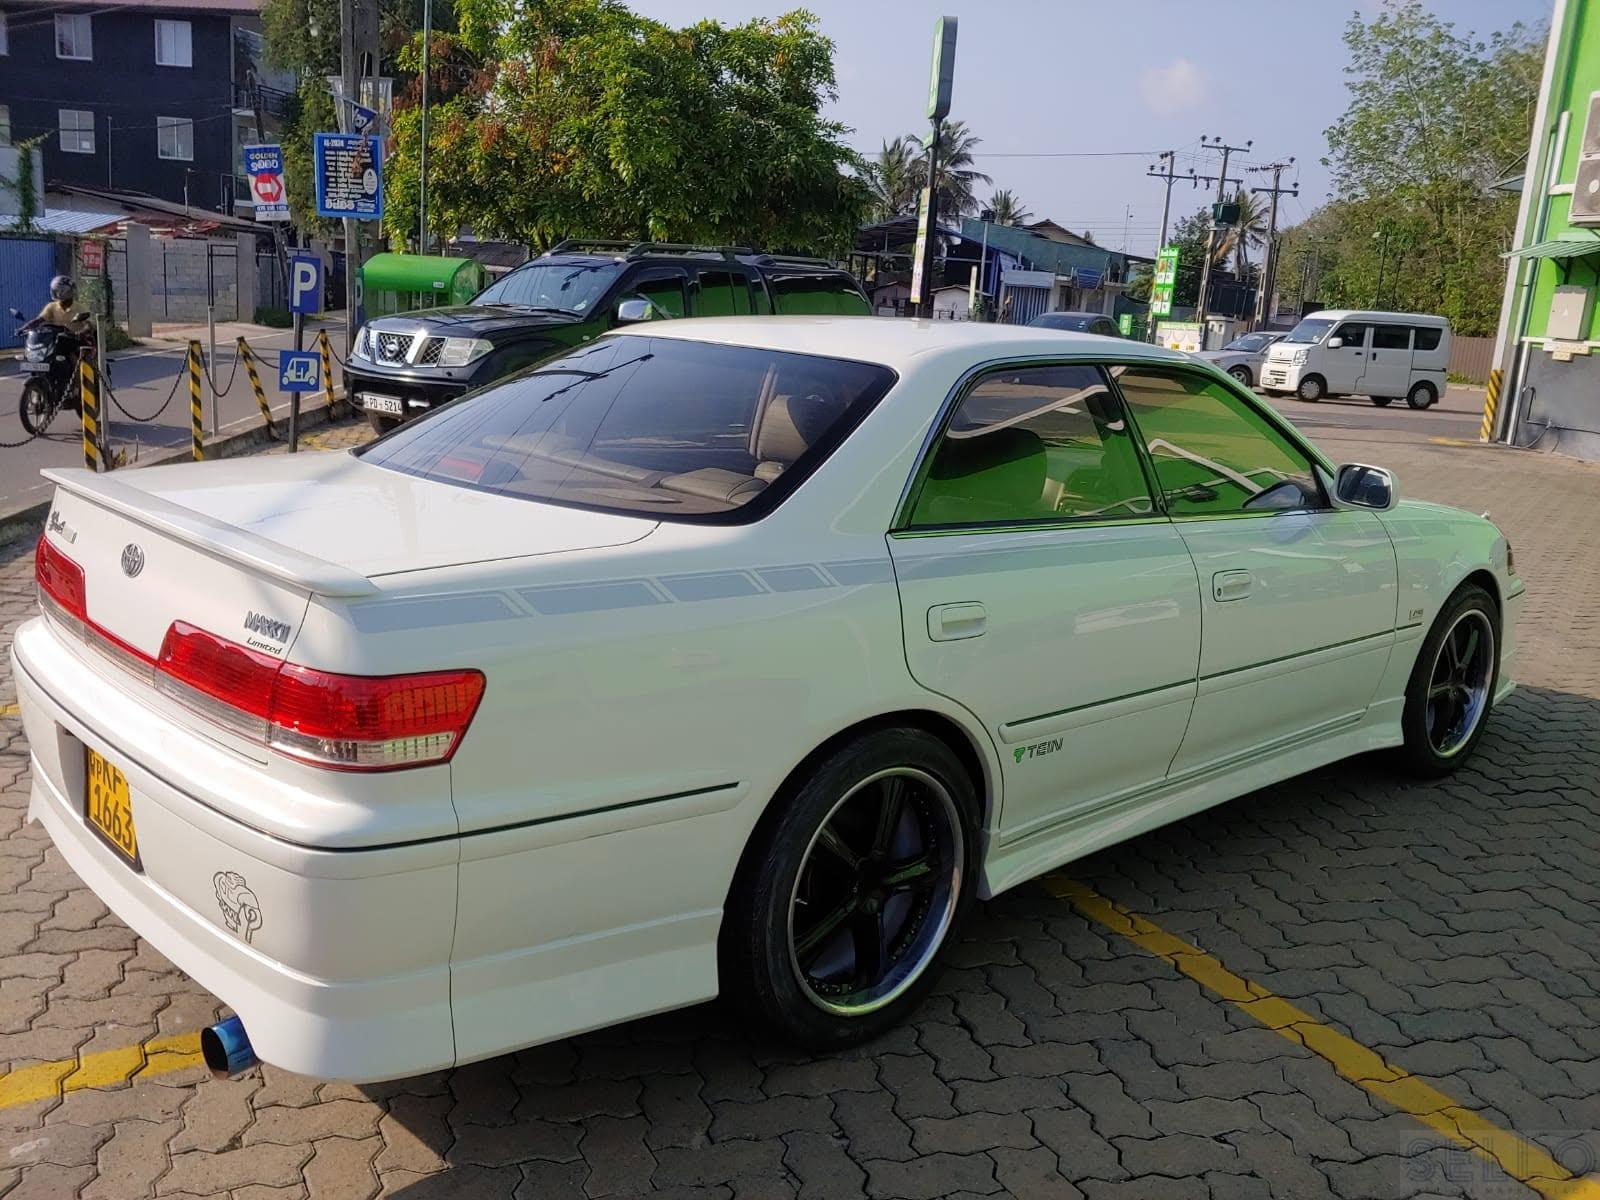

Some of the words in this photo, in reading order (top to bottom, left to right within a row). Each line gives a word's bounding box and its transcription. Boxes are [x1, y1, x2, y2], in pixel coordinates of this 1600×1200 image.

[249, 152, 278, 160] GOLDEN
[292, 261, 317, 308] P
[247, 637, 283, 655] Limited
[1027, 737, 1064, 759] TEIN
[94, 784, 133, 851] 1663
